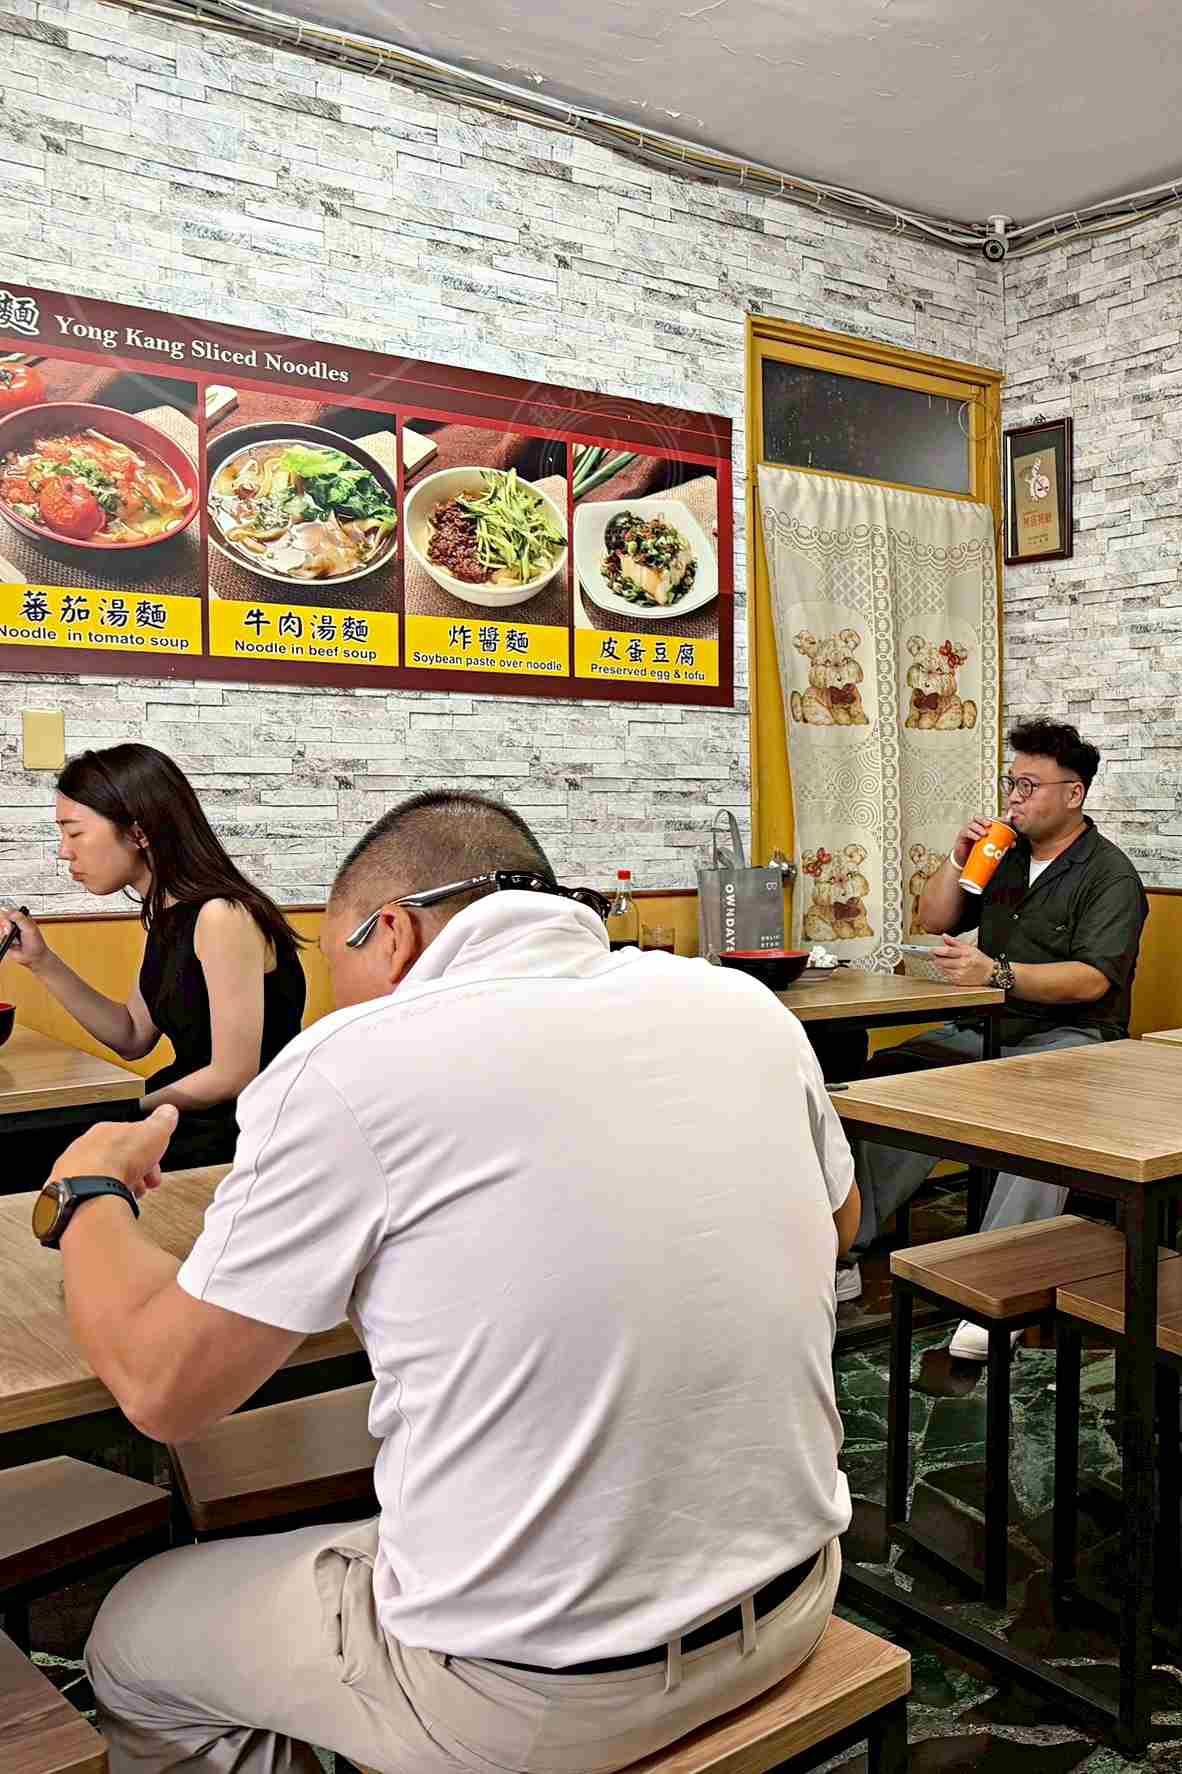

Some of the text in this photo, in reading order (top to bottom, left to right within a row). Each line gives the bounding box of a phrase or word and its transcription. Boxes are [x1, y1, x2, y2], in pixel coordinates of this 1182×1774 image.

[54, 315, 350, 383] Yong Kang Sliced Noodles
[19, 590, 167, 629] 蕃茄湯麵
[68, 628, 82, 641] in
[88, 631, 145, 645] tomato
[150, 636, 189, 650] soup
[244, 608, 368, 643] 牛肉湯麵
[449, 624, 529, 654] 炸醬麵
[234, 639, 377, 662] Noodle in beef soup
[413, 651, 562, 672] Soybean paste over noodle
[600, 636, 694, 667] 皮蛋豆腐
[591, 663, 705, 681] Preserved egg & tofu
